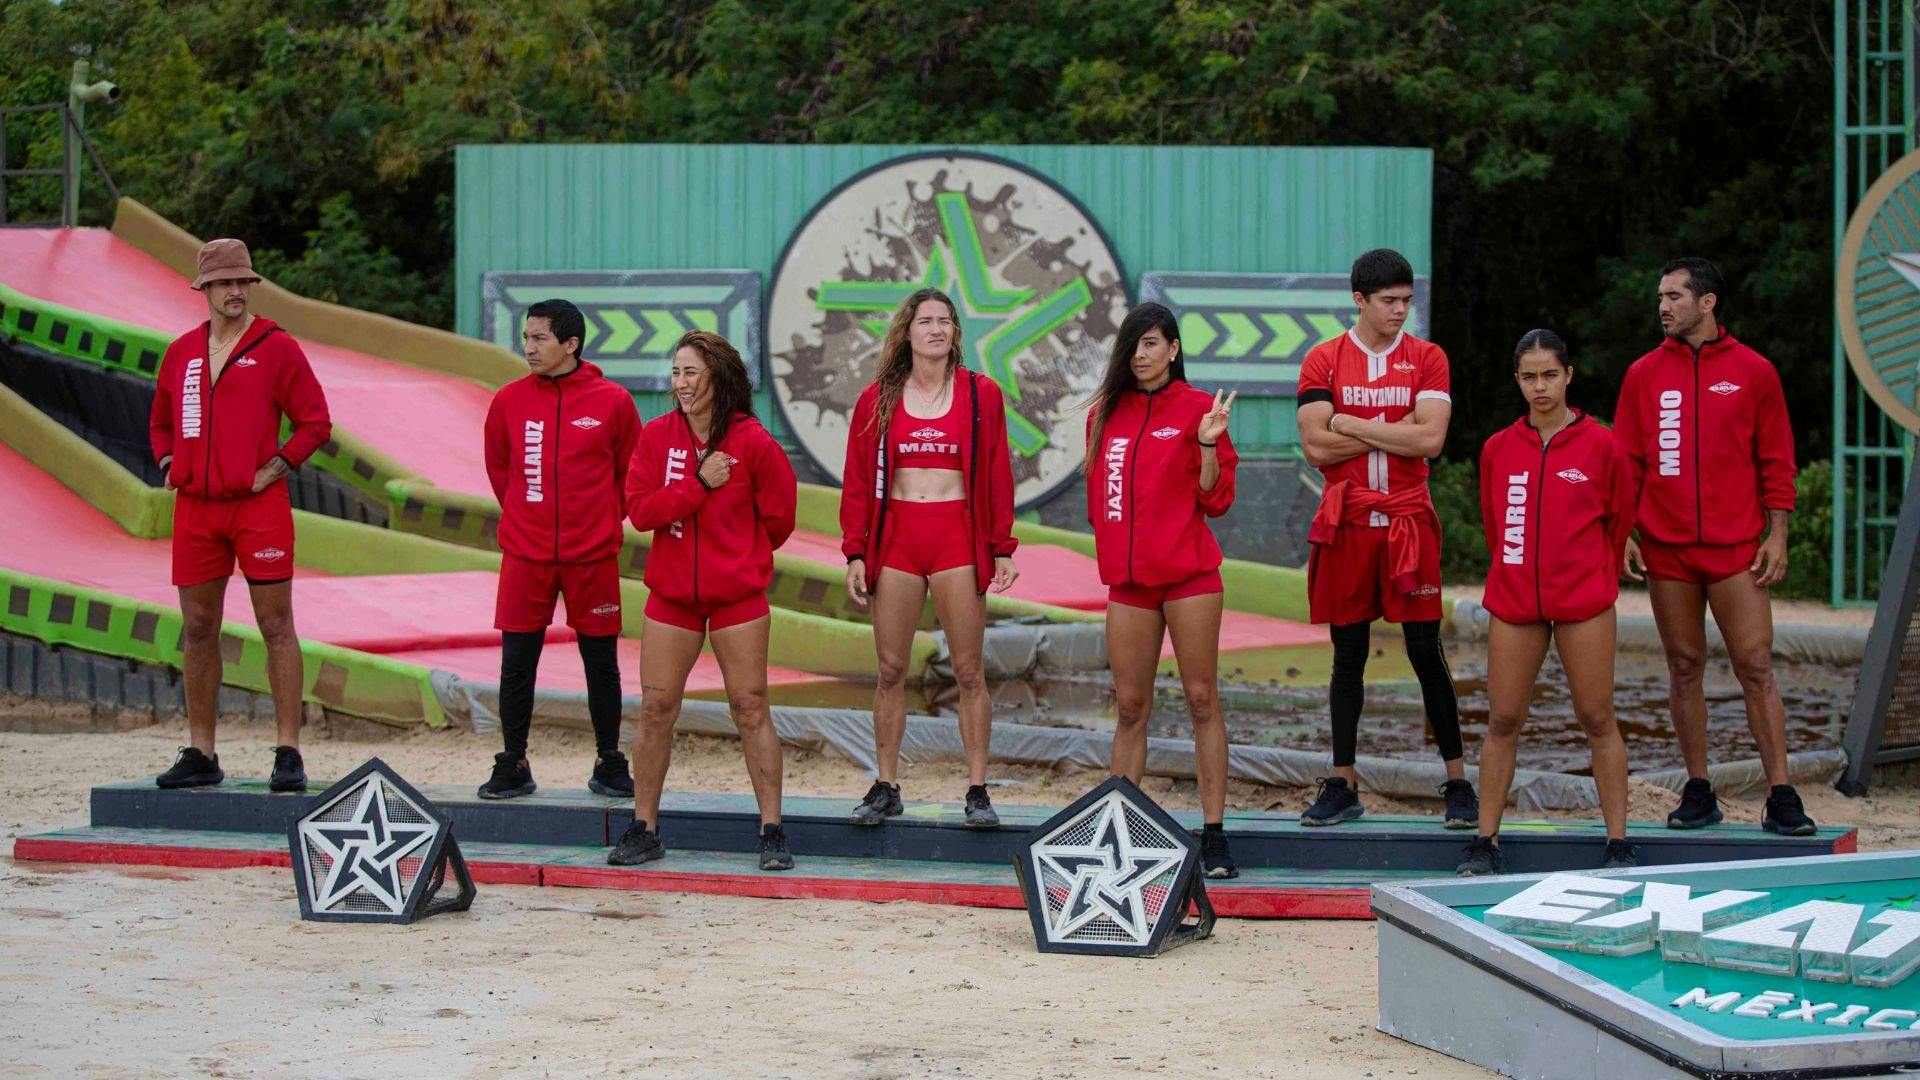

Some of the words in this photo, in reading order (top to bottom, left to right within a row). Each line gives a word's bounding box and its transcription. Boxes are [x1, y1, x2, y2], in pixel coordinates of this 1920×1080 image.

[182, 358, 203, 439] HUMBERTO
[1342, 386, 1411, 407] BENYAMIN
[1659, 390, 1682, 476] MONO
[524, 420, 544, 502] VILLALUZ
[899, 442, 958, 453] MATI
[1105, 438, 1130, 521] JAZMÍN
[1502, 471, 1529, 565] KAROL
[1669, 987, 1920, 1031] MEXIC
